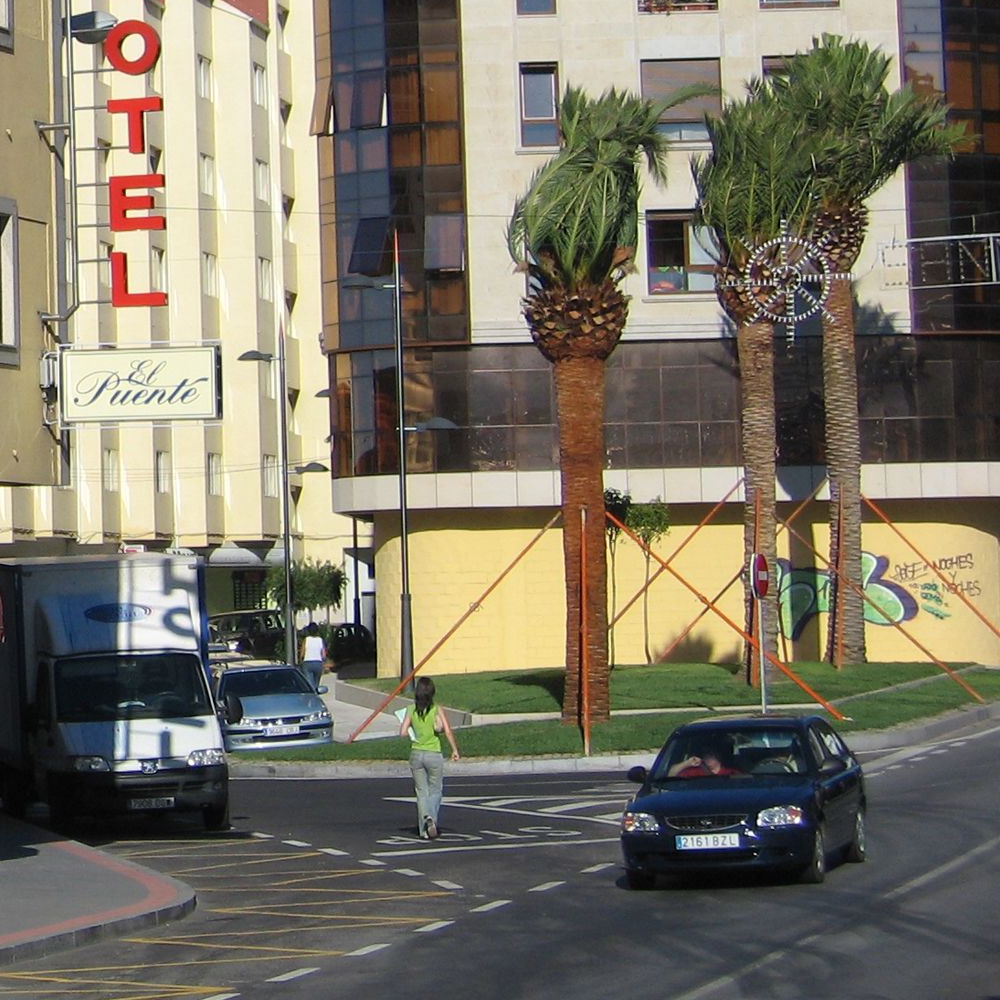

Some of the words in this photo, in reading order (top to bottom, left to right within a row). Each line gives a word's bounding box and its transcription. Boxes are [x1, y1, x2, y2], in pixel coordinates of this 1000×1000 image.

[127, 359, 167, 385] El
[73, 370, 209, 407] Puente
[682, 836, 709, 848] 2161
[712, 835, 737, 847] BZL
